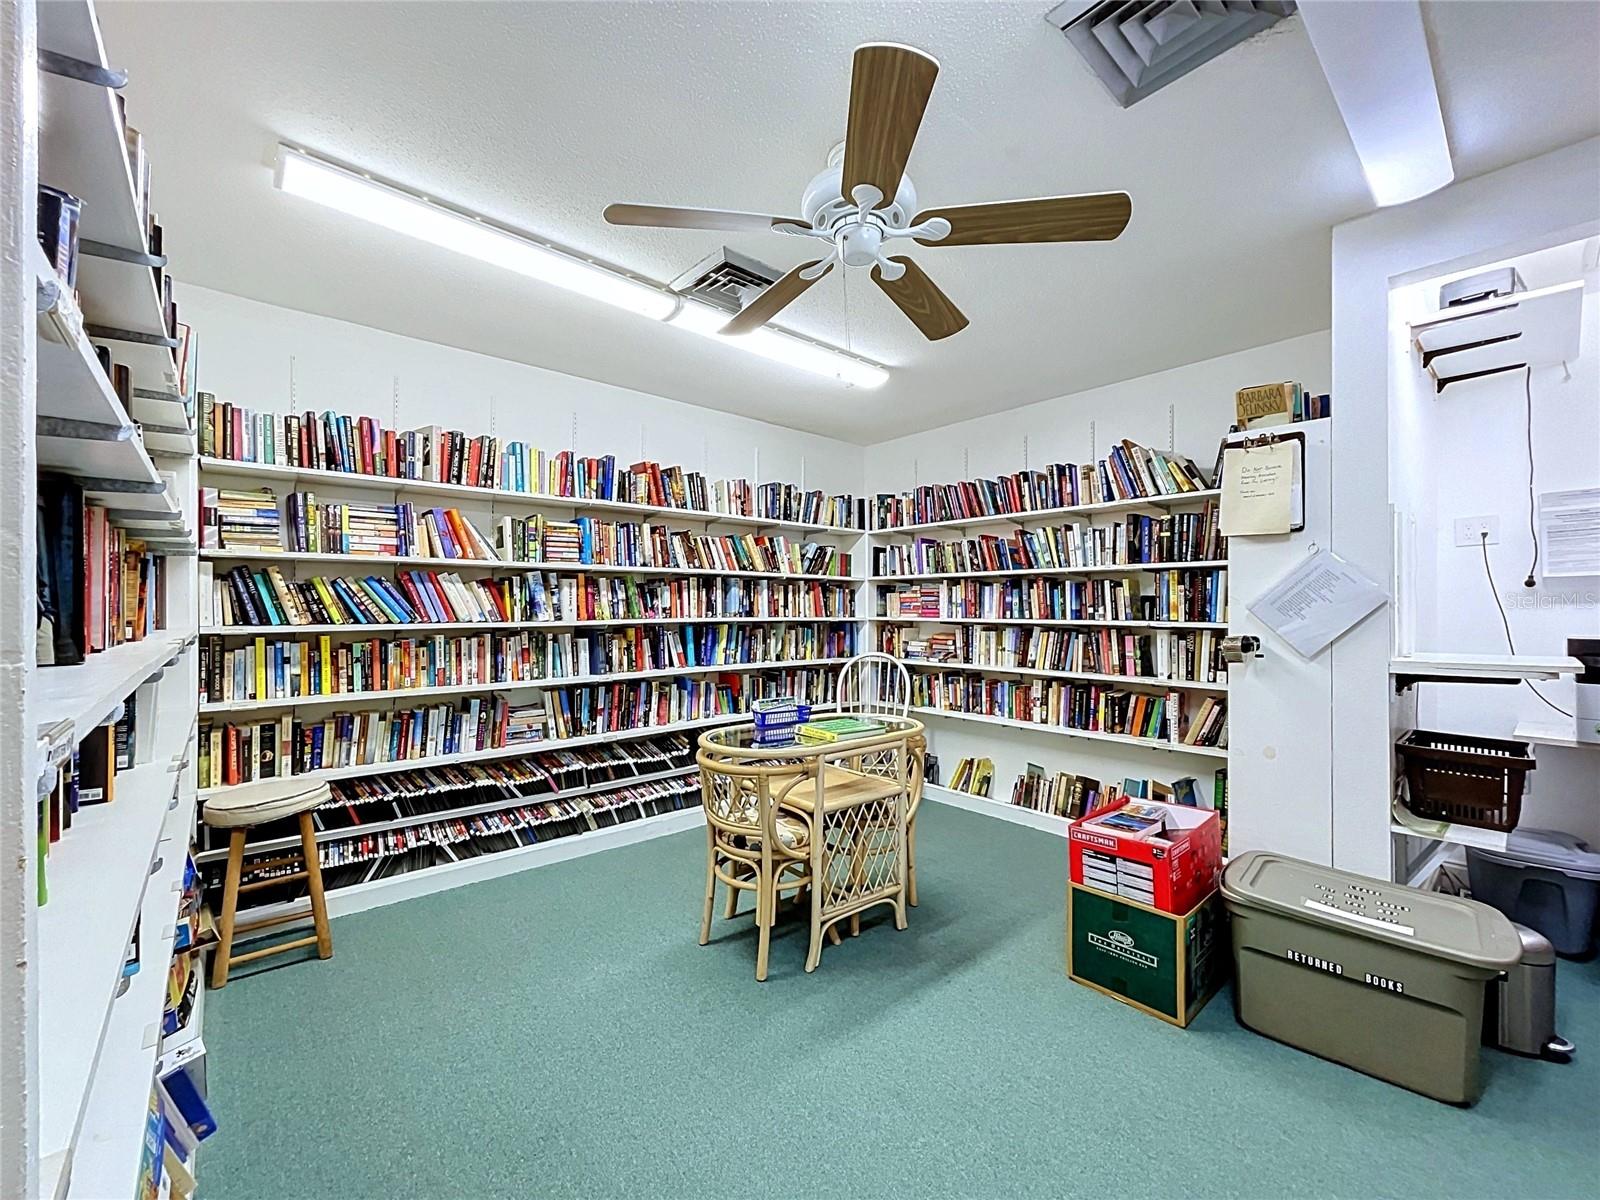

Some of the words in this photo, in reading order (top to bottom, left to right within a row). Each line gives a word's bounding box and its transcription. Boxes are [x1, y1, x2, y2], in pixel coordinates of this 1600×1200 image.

[1238, 387, 1282, 405] BARBARA
[1238, 399, 1282, 418] DELINSKY
[1074, 832, 1115, 847] CRAFTSMAN
[1287, 949, 1342, 975] RETURNED
[1365, 973, 1403, 993] BOOKS
